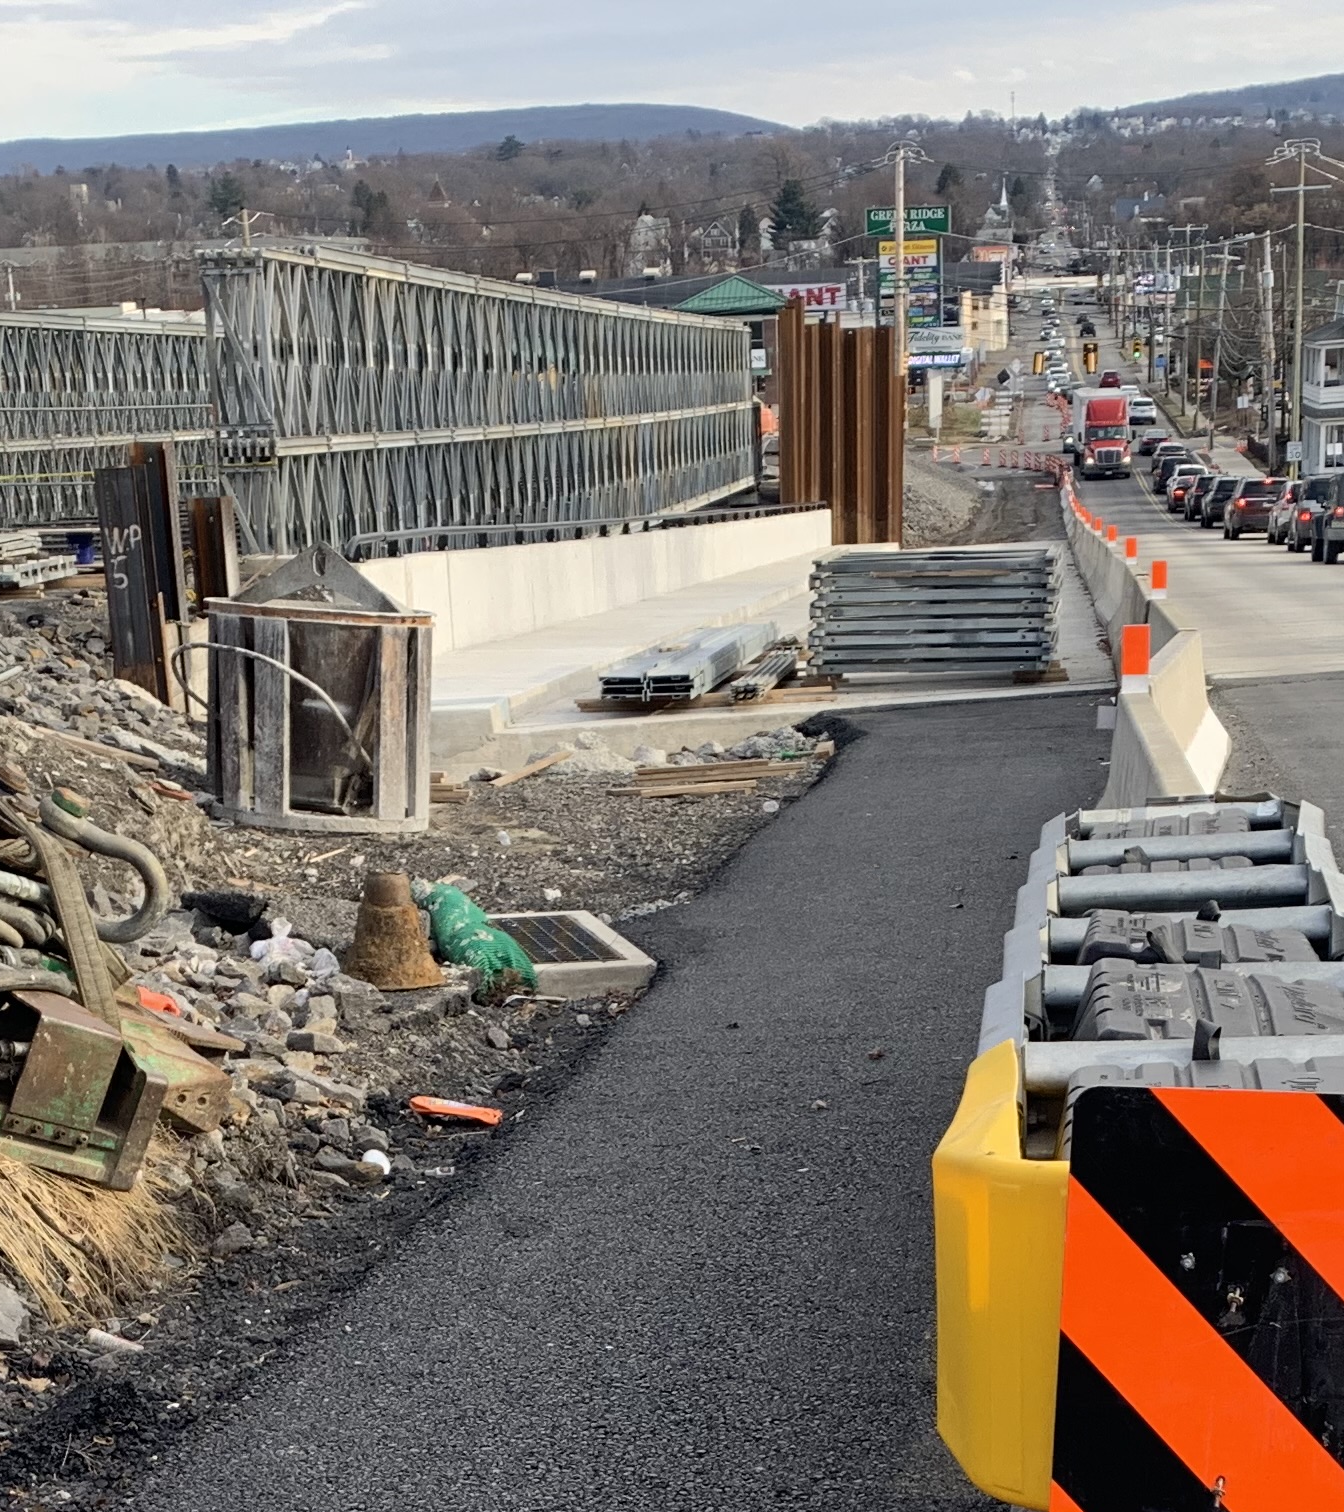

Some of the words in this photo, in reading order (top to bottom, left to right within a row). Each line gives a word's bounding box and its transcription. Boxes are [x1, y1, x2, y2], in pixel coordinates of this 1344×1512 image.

[910, 207, 946, 220] RIDGE
[889, 220, 926, 233] PAZA
[110, 555, 129, 589] 5
